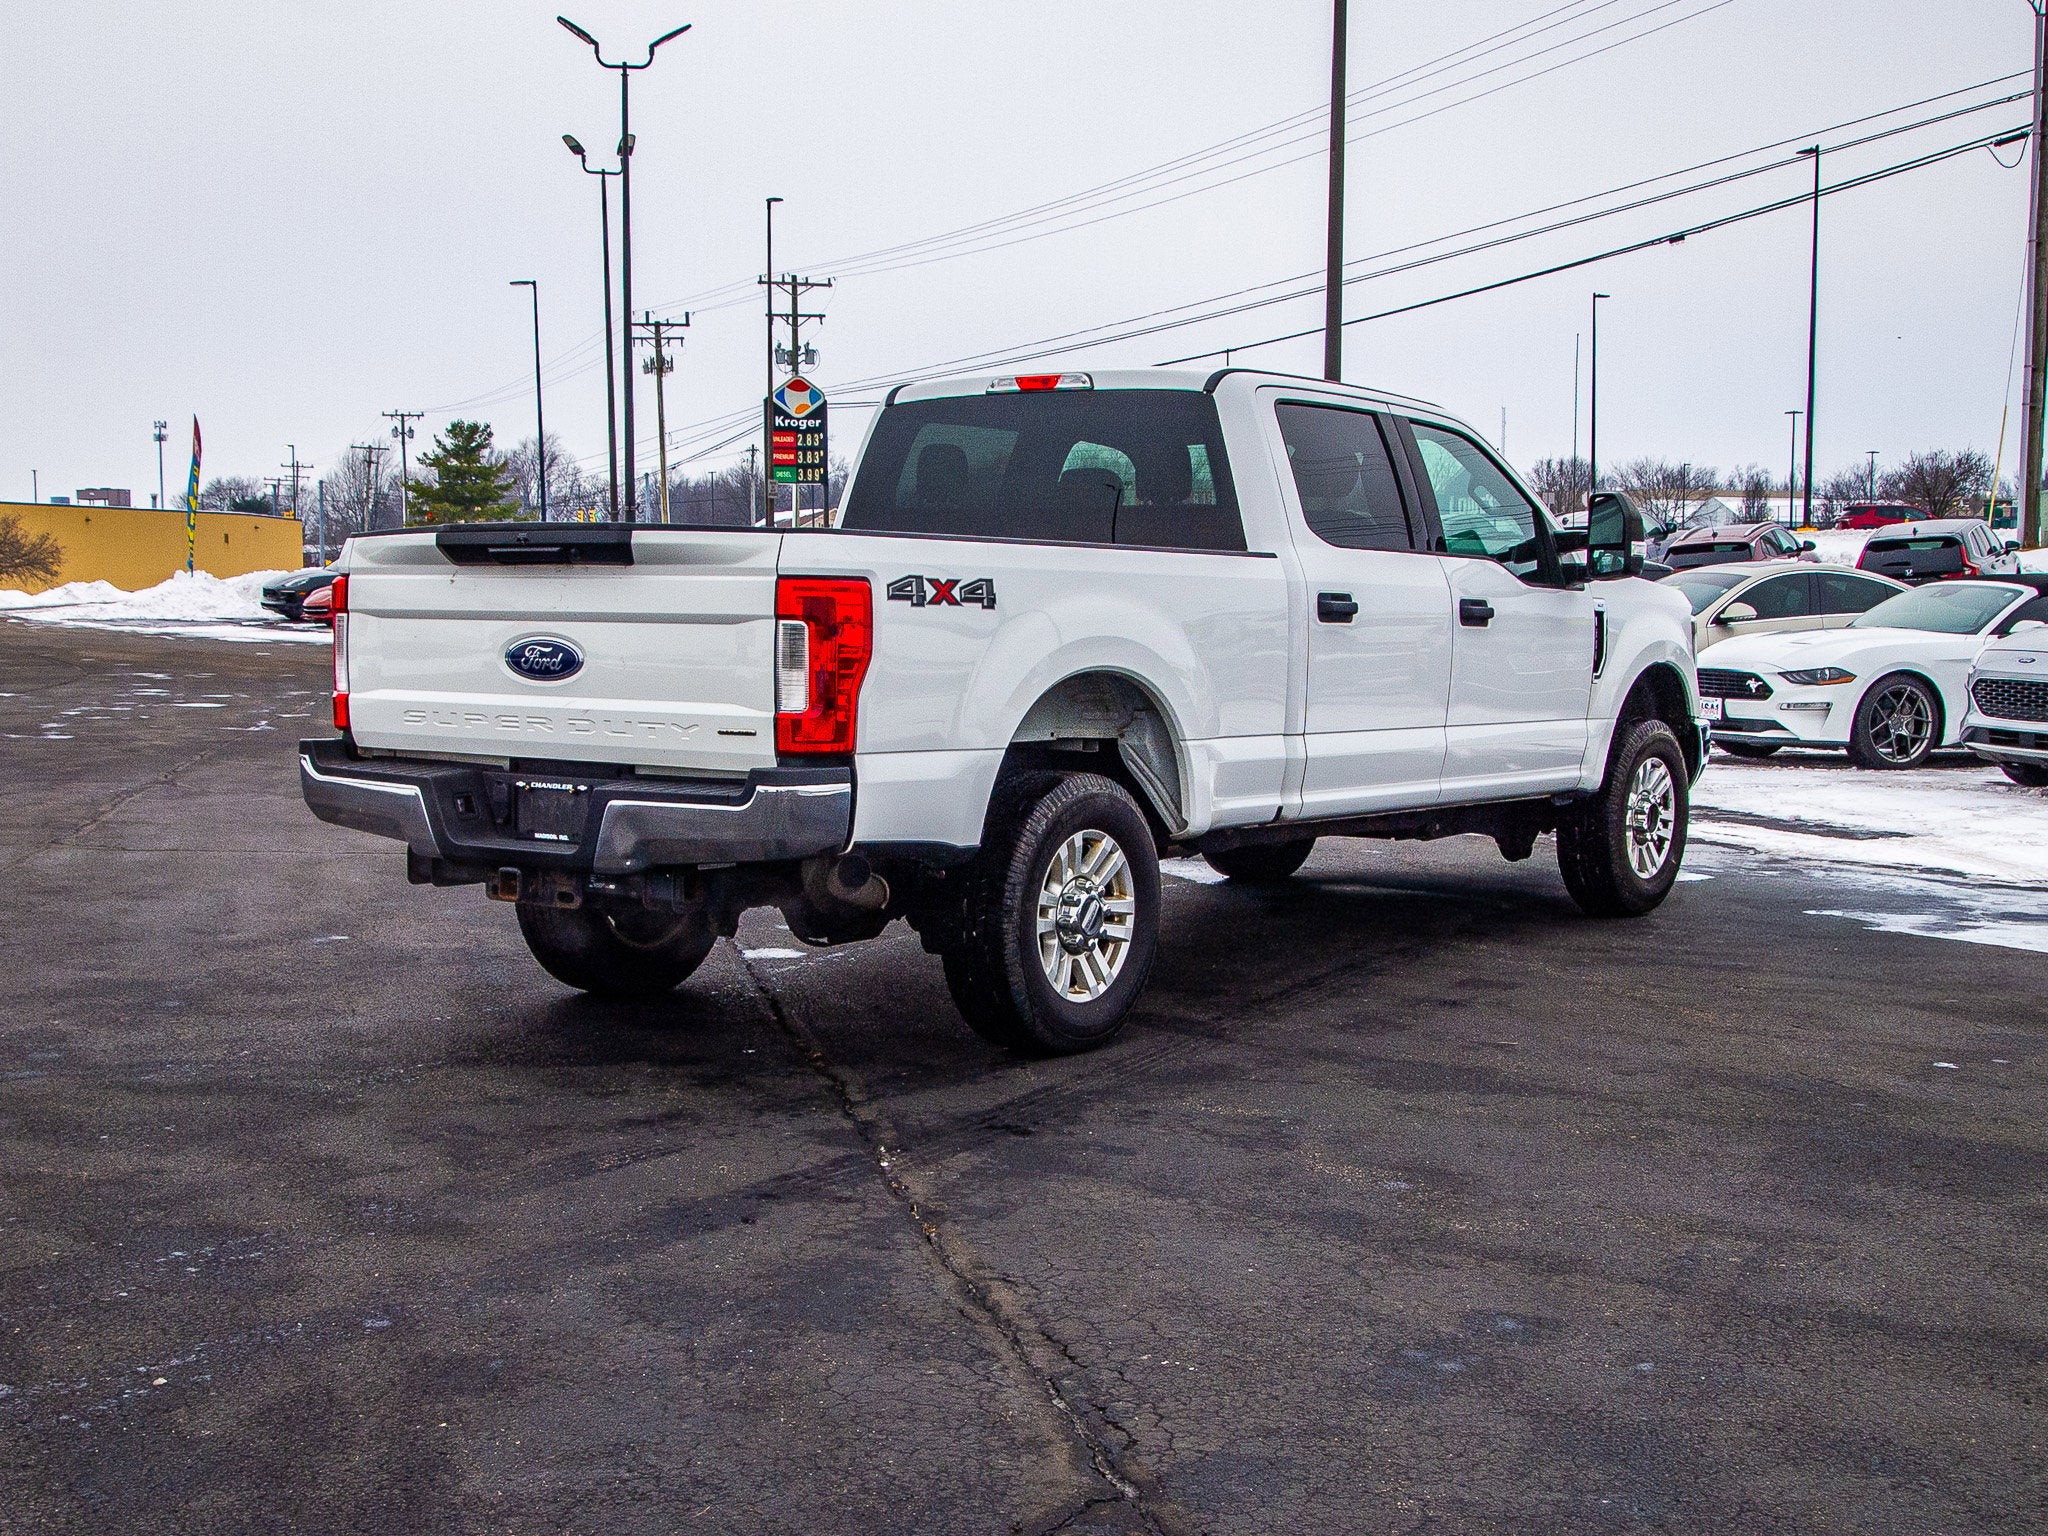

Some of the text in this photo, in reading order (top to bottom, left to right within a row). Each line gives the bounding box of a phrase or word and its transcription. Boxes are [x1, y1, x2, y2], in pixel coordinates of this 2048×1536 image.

[775, 416, 821, 429] Kroger
[521, 645, 563, 671] Ford
[403, 709, 699, 740] SUPER DUTY
[530, 782, 573, 790] CHANDLER
